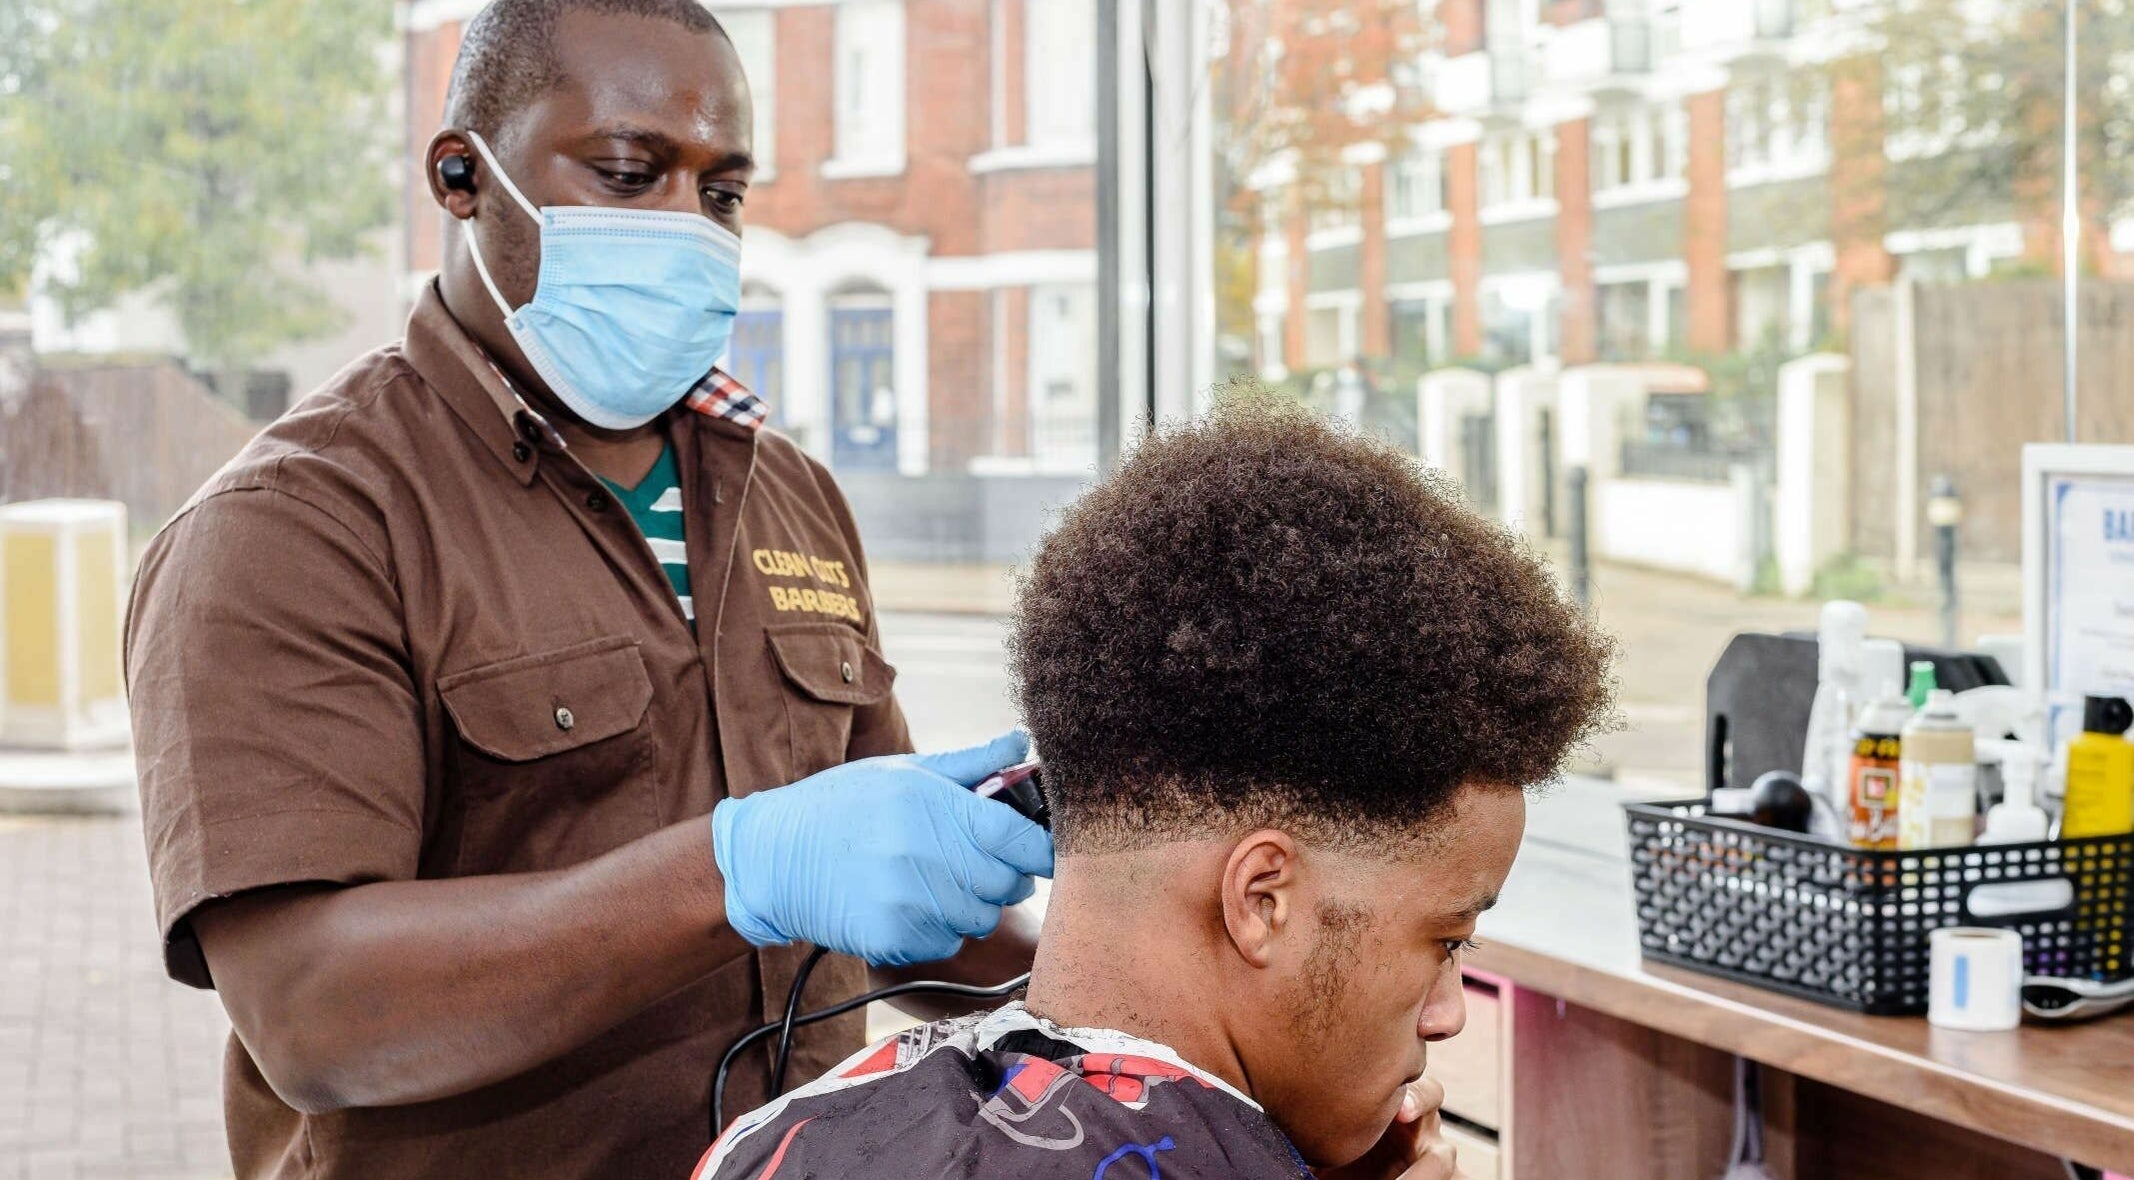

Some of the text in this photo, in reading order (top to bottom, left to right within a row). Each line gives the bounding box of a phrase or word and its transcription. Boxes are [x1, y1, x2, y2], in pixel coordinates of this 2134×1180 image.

[2103, 509, 2134, 541] BA
[753, 549, 850, 588] CLEAN CUTS
[768, 586, 861, 622] BARBERS
